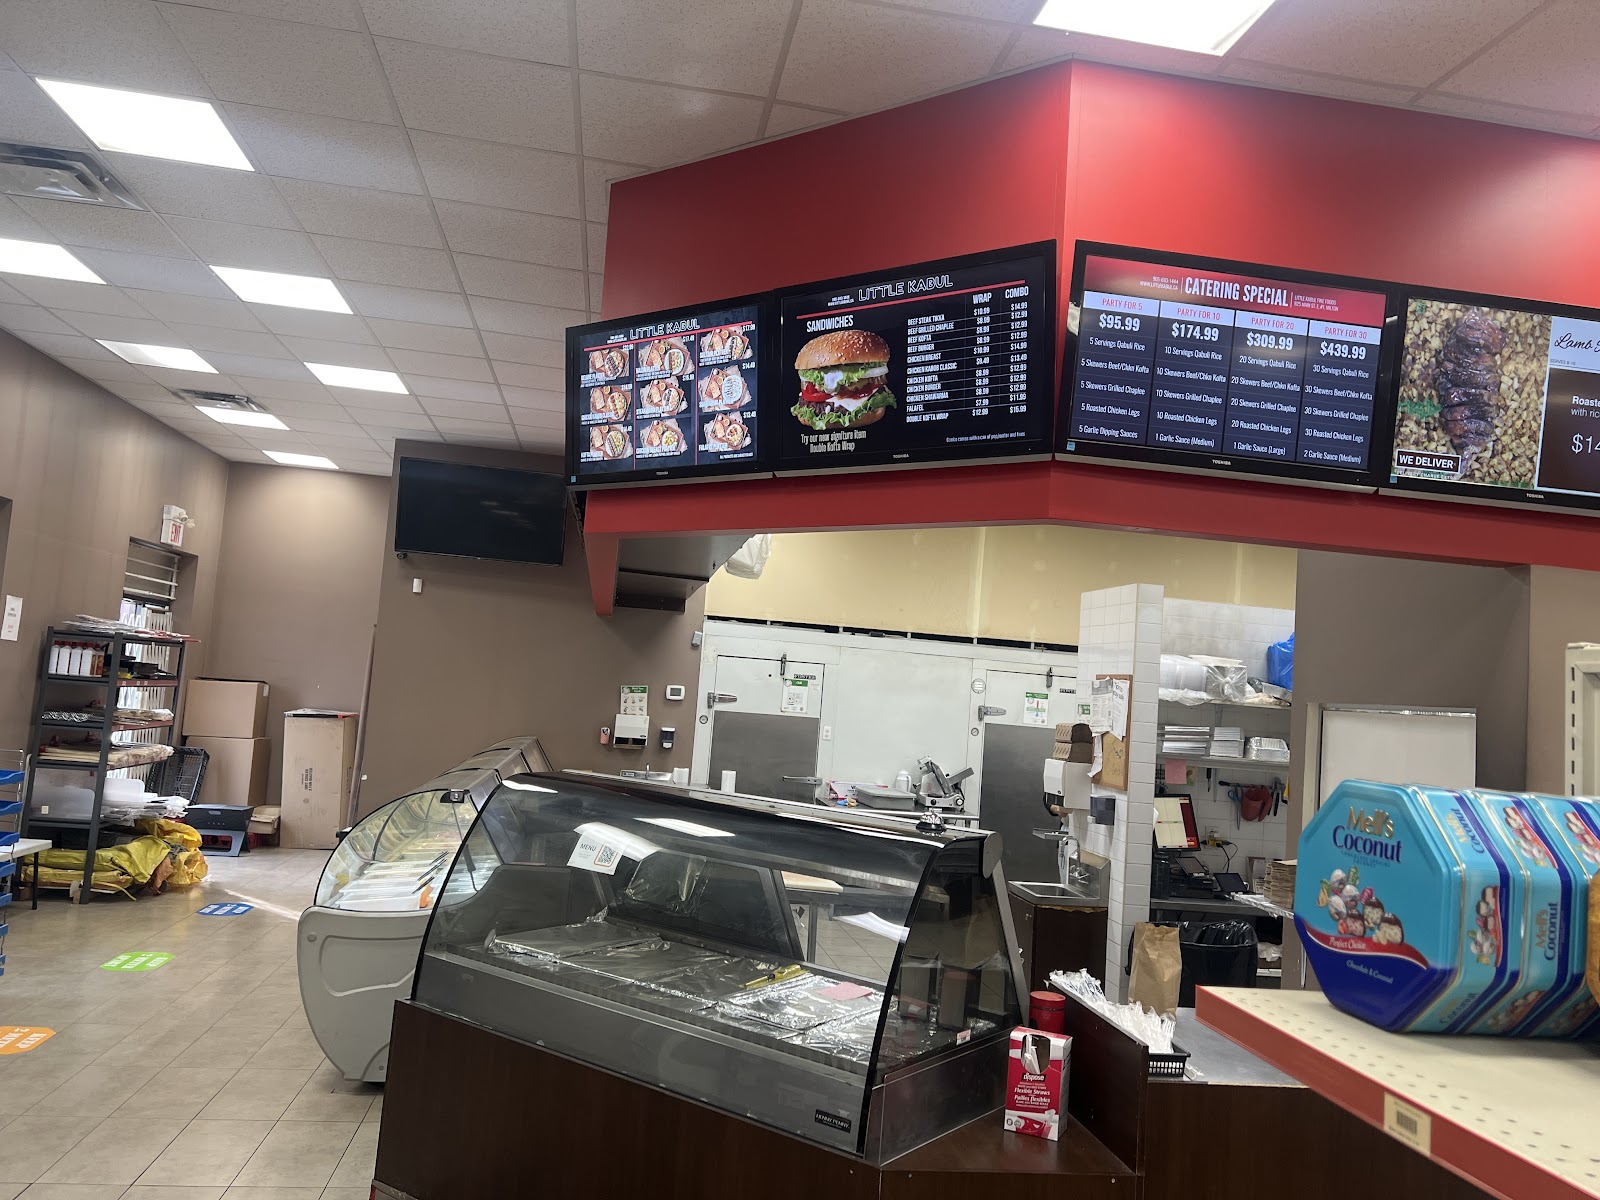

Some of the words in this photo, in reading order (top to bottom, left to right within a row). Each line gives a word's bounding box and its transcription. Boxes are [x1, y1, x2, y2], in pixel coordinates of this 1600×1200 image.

[858, 282, 904, 302] LITTLE
[908, 275, 953, 294] KABUL
[1005, 286, 1028, 298] COMBO
[1185, 276, 1240, 301] CATERING
[1243, 284, 1288, 306] SPECIAL
[973, 292, 992, 304] WRAP
[1102, 298, 1122, 308] PARTY
[1124, 301, 1137, 310] FOR
[1138, 302, 1143, 310] 5
[1178, 308, 1198, 318] PARTY
[1198, 310, 1211, 320] FOR
[1212, 312, 1220, 320] 10
[630, 324, 664, 340] LITTLE
[666, 318, 700, 334] KABUL
[806, 315, 854, 332] SANDWICHES
[908, 318, 918, 326] BEEF
[1099, 313, 1140, 332] $95.99
[1252, 318, 1270, 326] PARTY
[1272, 320, 1284, 328] FOR
[1286, 322, 1294, 330] 20
[1172, 322, 1219, 342] $174.99
[1325, 327, 1344, 336] PARTY
[1345, 330, 1357, 338] FOR
[1358, 331, 1368, 340] 30
[1090, 336, 1094, 344] 5
[1094, 338, 1116, 349] Servings
[1117, 340, 1133, 350] Qabuli
[1134, 342, 1146, 352] Rice
[1246, 331, 1294, 350] $309.99
[1554, 332, 1593, 350] Lamb
[1164, 346, 1172, 354] 10
[1172, 347, 1194, 358] Servings
[1194, 350, 1210, 359] Qabuli
[1211, 352, 1222, 361] Rice
[1320, 340, 1366, 360] $439.99
[1081, 358, 1086, 366] 5
[1086, 360, 1108, 369] Skewers
[1136, 364, 1150, 374] Kofta
[1240, 356, 1247, 364] 20
[1248, 356, 1268, 368] Servings
[1269, 358, 1284, 368] Qabuli
[1286, 360, 1296, 370] Rice
[1156, 368, 1164, 376] 10
[1164, 368, 1186, 378] Skewers
[1212, 373, 1226, 383] Kofta
[1312, 364, 1320, 372] 30
[1321, 365, 1342, 376] Servings
[1342, 368, 1357, 378] Qabuli
[1358, 370, 1370, 379] Rice
[1080, 380, 1085, 388] 5
[1086, 382, 1107, 392] Skewers
[1108, 384, 1124, 393] Grilled
[1231, 376, 1239, 384] 20
[1240, 377, 1260, 387] Skewers
[1287, 382, 1300, 392] Kofta
[1156, 389, 1163, 397] 10
[1164, 390, 1184, 400] Skewers
[1185, 392, 1202, 402] Grilled
[1304, 385, 1312, 393] 30
[1313, 386, 1334, 396] Skewers
[1360, 391, 1373, 400] Kofta
[1081, 403, 1086, 411] 5
[1086, 404, 1106, 413] Roasted
[1108, 406, 1128, 416] Chicken
[1128, 408, 1140, 418] Legs
[1230, 398, 1238, 406] 20
[1239, 399, 1260, 409] Skewers
[1260, 401, 1276, 411] Grilled
[1304, 406, 1312, 414] 30
[1312, 408, 1333, 418] Skewers
[1334, 410, 1350, 420] Grilled
[1570, 408, 1588, 416] with
[1156, 412, 1164, 420] 10
[1164, 412, 1184, 422] Roasted
[1184, 415, 1204, 424] Chicken
[1205, 418, 1218, 427] Legs
[1079, 424, 1084, 432] 5
[1084, 426, 1099, 434] Garlic
[1100, 428, 1120, 438] Dipping
[1120, 429, 1138, 438] Sauces
[1231, 420, 1240, 428] 20
[1240, 421, 1260, 430] Roasted
[1260, 423, 1280, 432] Chicken
[1280, 425, 1292, 434] Legs
[810, 434, 818, 442] our
[819, 434, 830, 442] new
[854, 430, 866, 440] item
[1160, 434, 1174, 443] Garlic
[1174, 436, 1190, 445] Sauce
[1190, 436, 1214, 448] (Medium)
[1304, 428, 1312, 436] 30
[1313, 430, 1332, 439] Roasted
[1333, 432, 1352, 441] Chicken
[1352, 434, 1364, 444] Legs
[810, 442, 826, 453] Double
[842, 441, 855, 452] Wrap
[1238, 442, 1252, 452] Garlic
[1252, 444, 1268, 453] Sauce
[1268, 445, 1286, 456] (Large)
[1304, 450, 1308, 458] 2
[1308, 450, 1323, 460] Garlic
[1324, 452, 1338, 461] Sauce
[1338, 453, 1362, 464] (Medium)
[1399, 454, 1414, 464] WE
[1416, 456, 1454, 468] DELIVER
[170, 524, 182, 544] EXIT
[1347, 806, 1394, 838] Mell's
[1450, 808, 1484, 854] Coconut
[580, 843, 597, 851] MENU
[1332, 824, 1402, 862] Coconut
[1544, 902, 1558, 961] Coconut
[1330, 936, 1348, 948] Perfect
[1348, 939, 1366, 949] Choice
[1023, 1072, 1044, 1081] dispose
